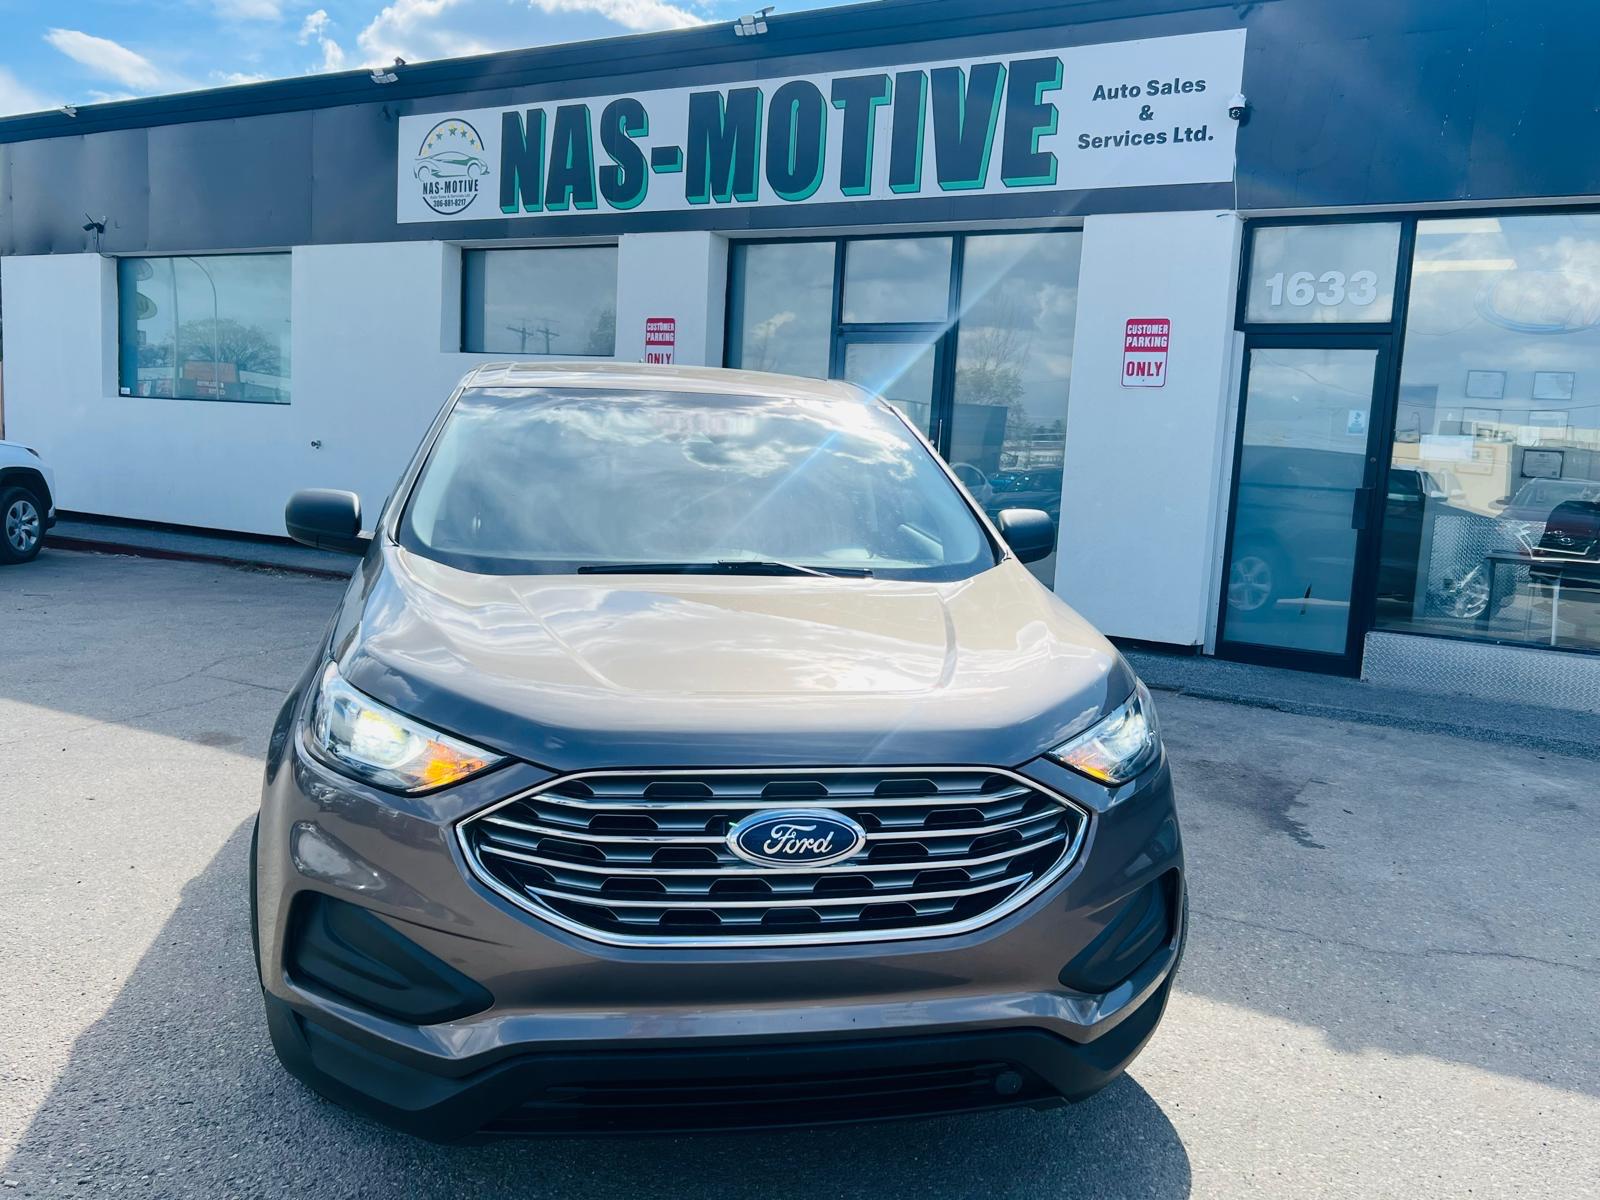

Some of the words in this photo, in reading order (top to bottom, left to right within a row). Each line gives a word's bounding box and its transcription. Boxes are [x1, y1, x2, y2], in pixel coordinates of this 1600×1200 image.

[1092, 84, 1141, 101] Auto
[1146, 78, 1206, 96] Sales
[1138, 104, 1154, 121] &
[500, 57, 1063, 214] NAS-MOTIVE
[1077, 130, 1168, 150] Services
[1173, 125, 1214, 143] Ltd.
[423, 179, 479, 195] NAS-MOTIVE
[1265, 270, 1377, 306] 1633
[646, 332, 675, 342] PARKING
[1127, 324, 1169, 335] CUSTOMER
[1126, 336, 1168, 348] PARKING
[1126, 361, 1163, 376] ONLY
[763, 823, 834, 855] Ford
